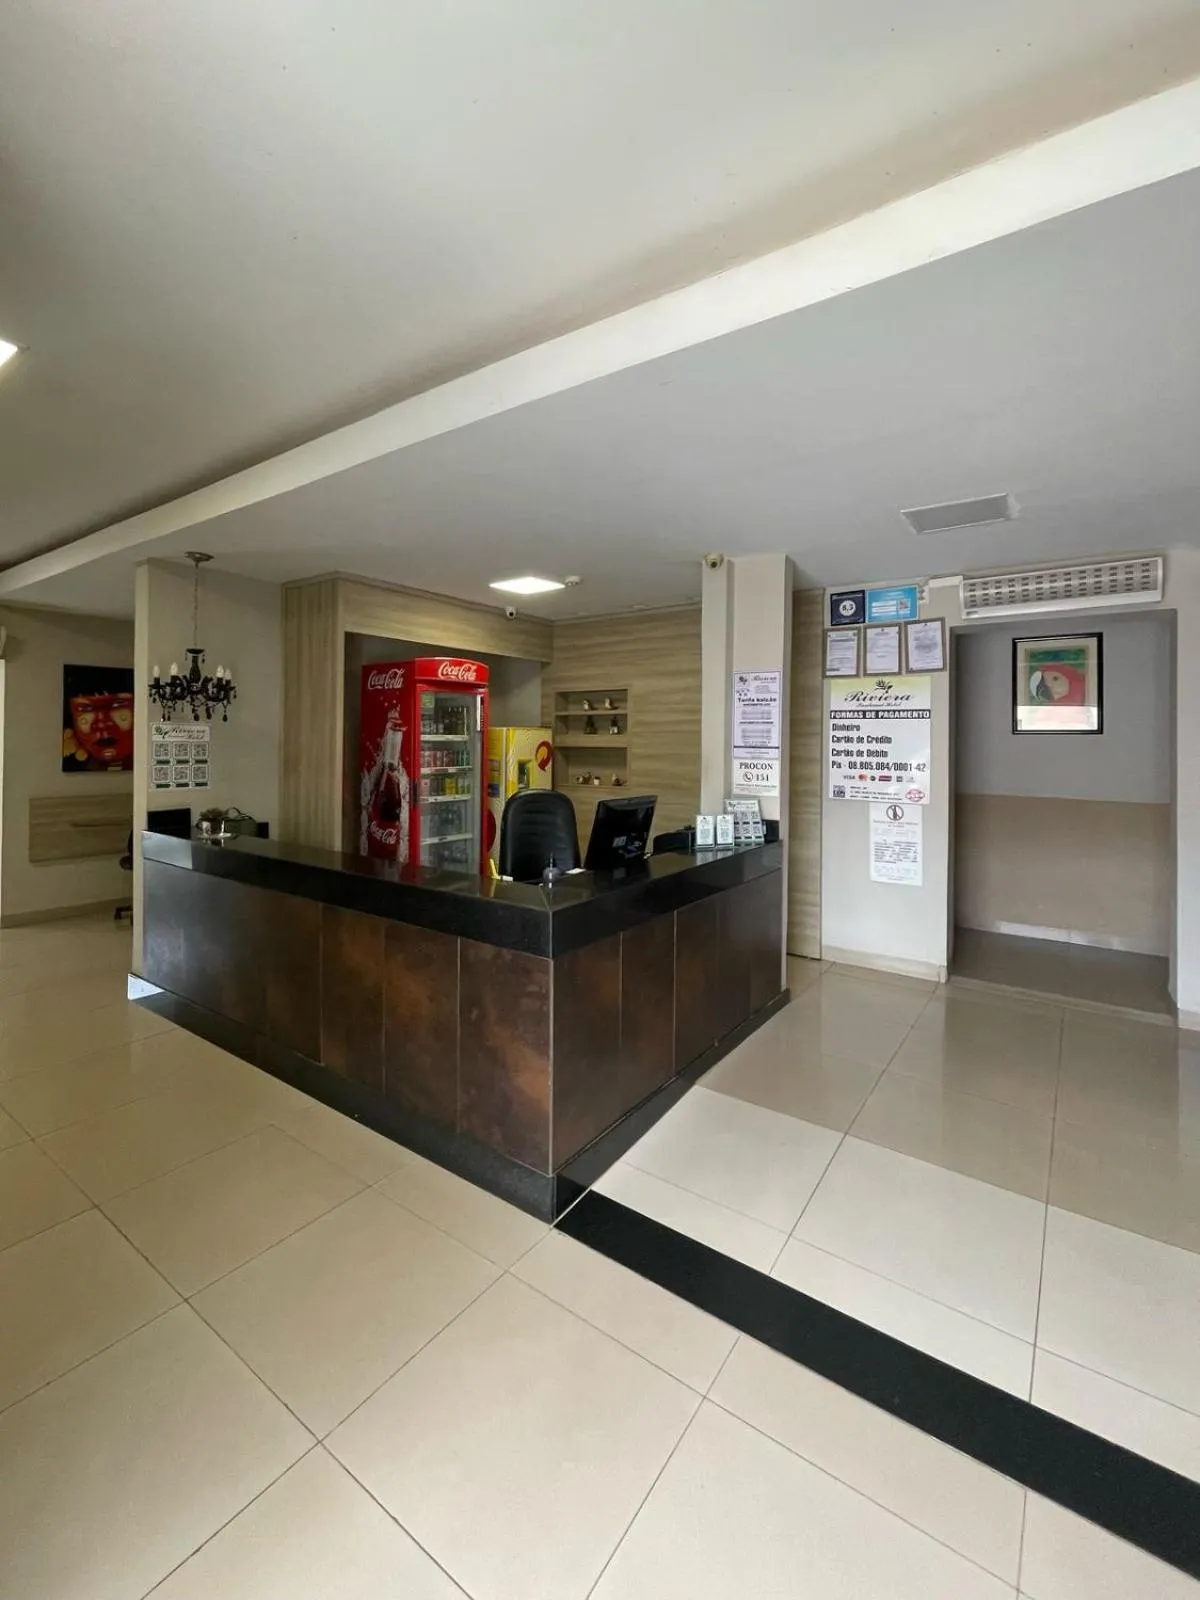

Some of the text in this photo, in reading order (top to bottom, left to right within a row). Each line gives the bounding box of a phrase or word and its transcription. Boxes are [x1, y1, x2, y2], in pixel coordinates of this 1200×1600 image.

[844, 690, 913, 702] Riviera
[831, 711, 930, 719] FORMAS DE PAGAMENTO
[832, 723, 861, 732] Dinheiro
[832, 735, 893, 744] Cartão de Crédito
[832, 748, 889, 758] Cartão de Débito
[739, 762, 773, 770] PROCON
[756, 773, 769, 781] 151
